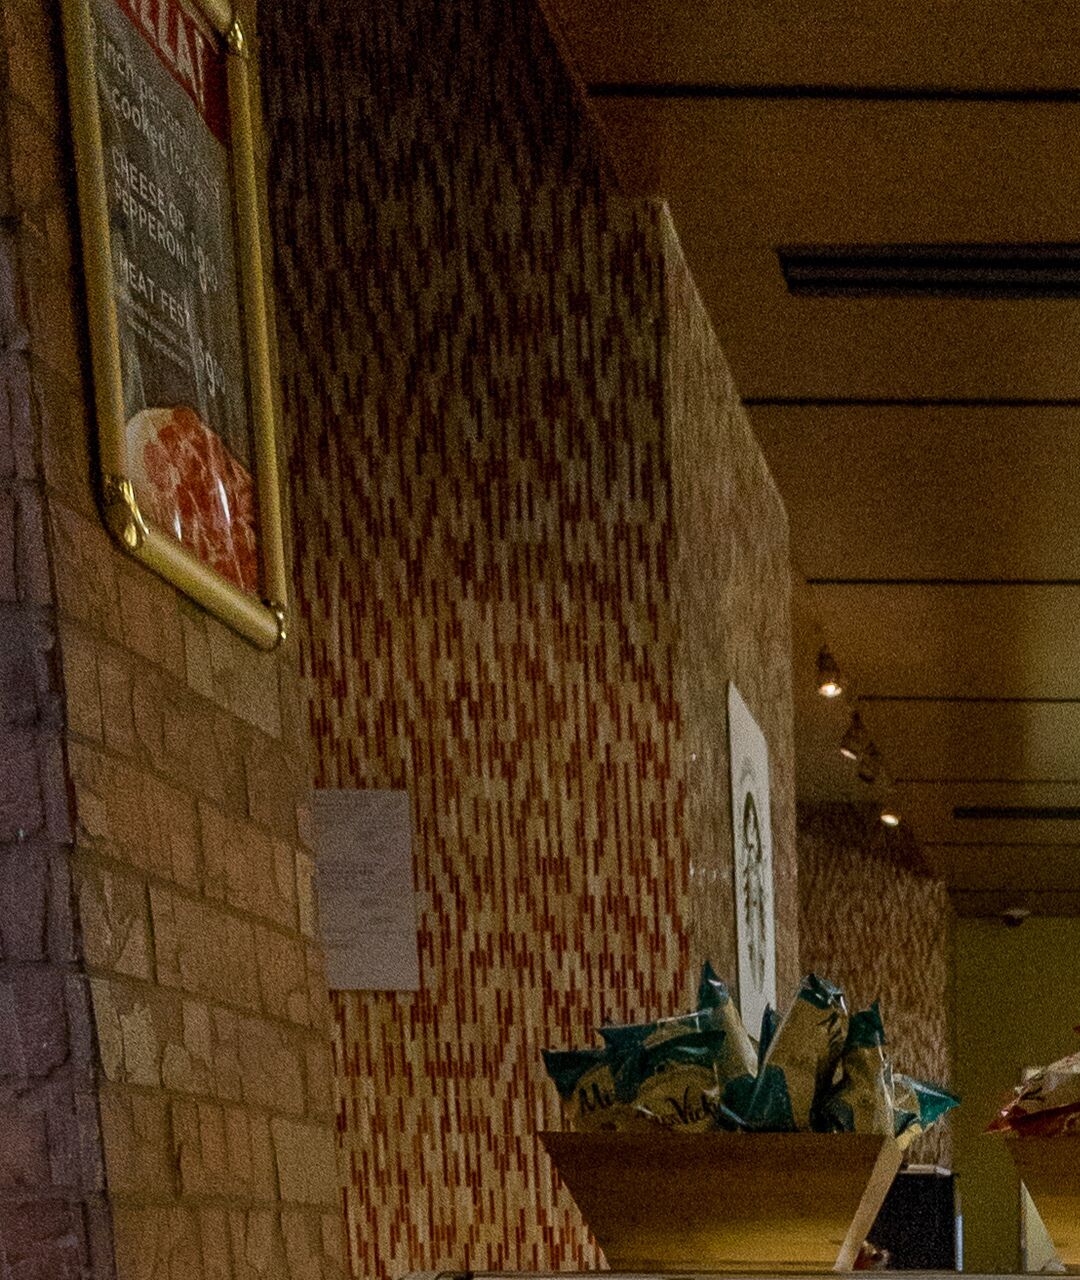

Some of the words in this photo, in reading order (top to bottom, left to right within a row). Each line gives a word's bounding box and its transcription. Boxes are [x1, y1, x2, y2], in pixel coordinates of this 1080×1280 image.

[111, 145, 165, 217] CHEESE
[114, 178, 188, 268] PEPPERONI
[119, 254, 155, 304] MEAT
